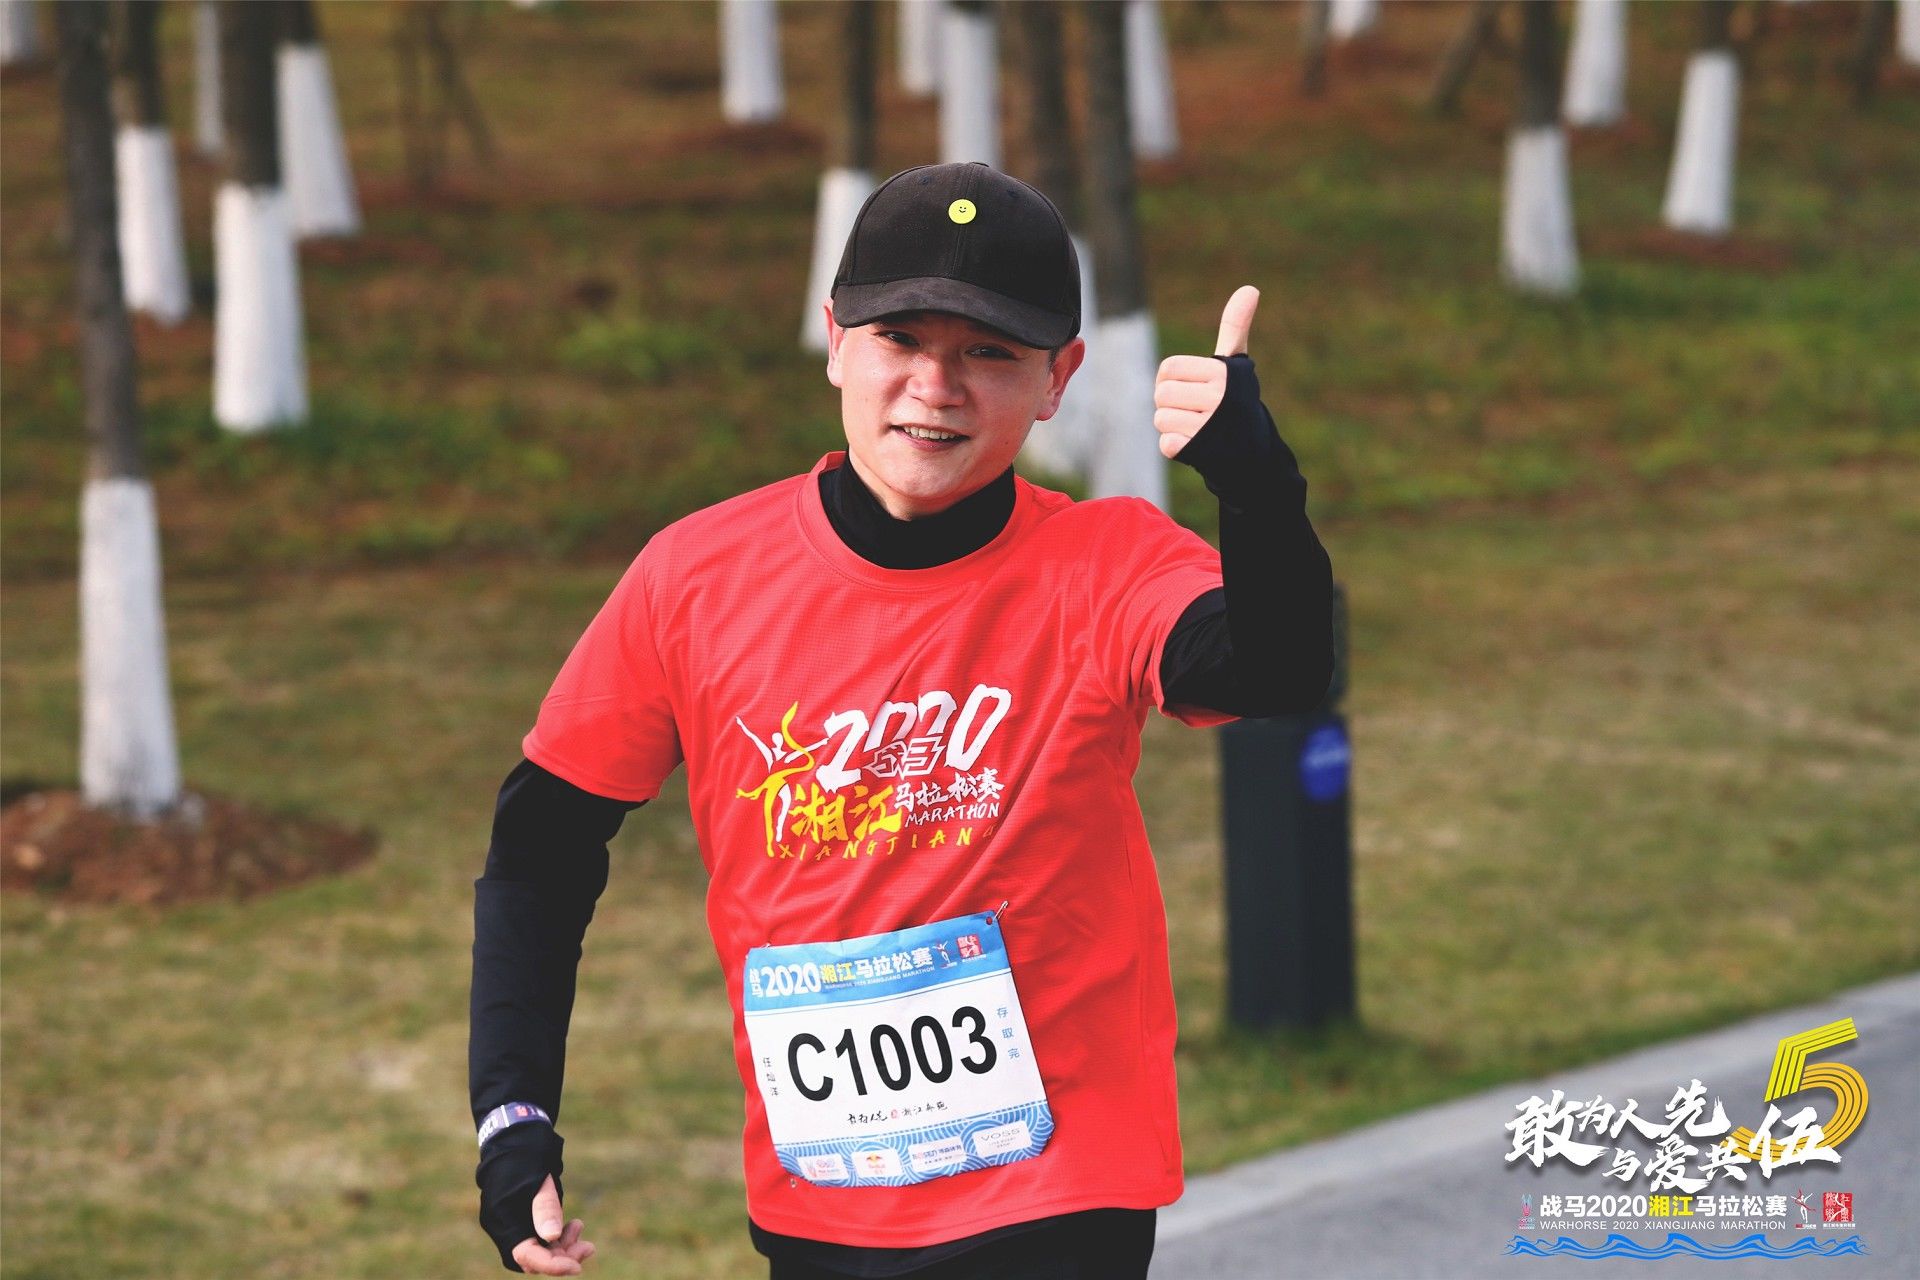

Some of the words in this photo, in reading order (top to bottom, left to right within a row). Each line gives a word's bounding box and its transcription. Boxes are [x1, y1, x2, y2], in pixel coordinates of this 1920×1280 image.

[790, 782, 903, 844] 湘江
[894, 766, 1006, 812] 马拉松赛
[904, 802, 1000, 828] MARATHON
[787, 1005, 998, 1103] C1003
